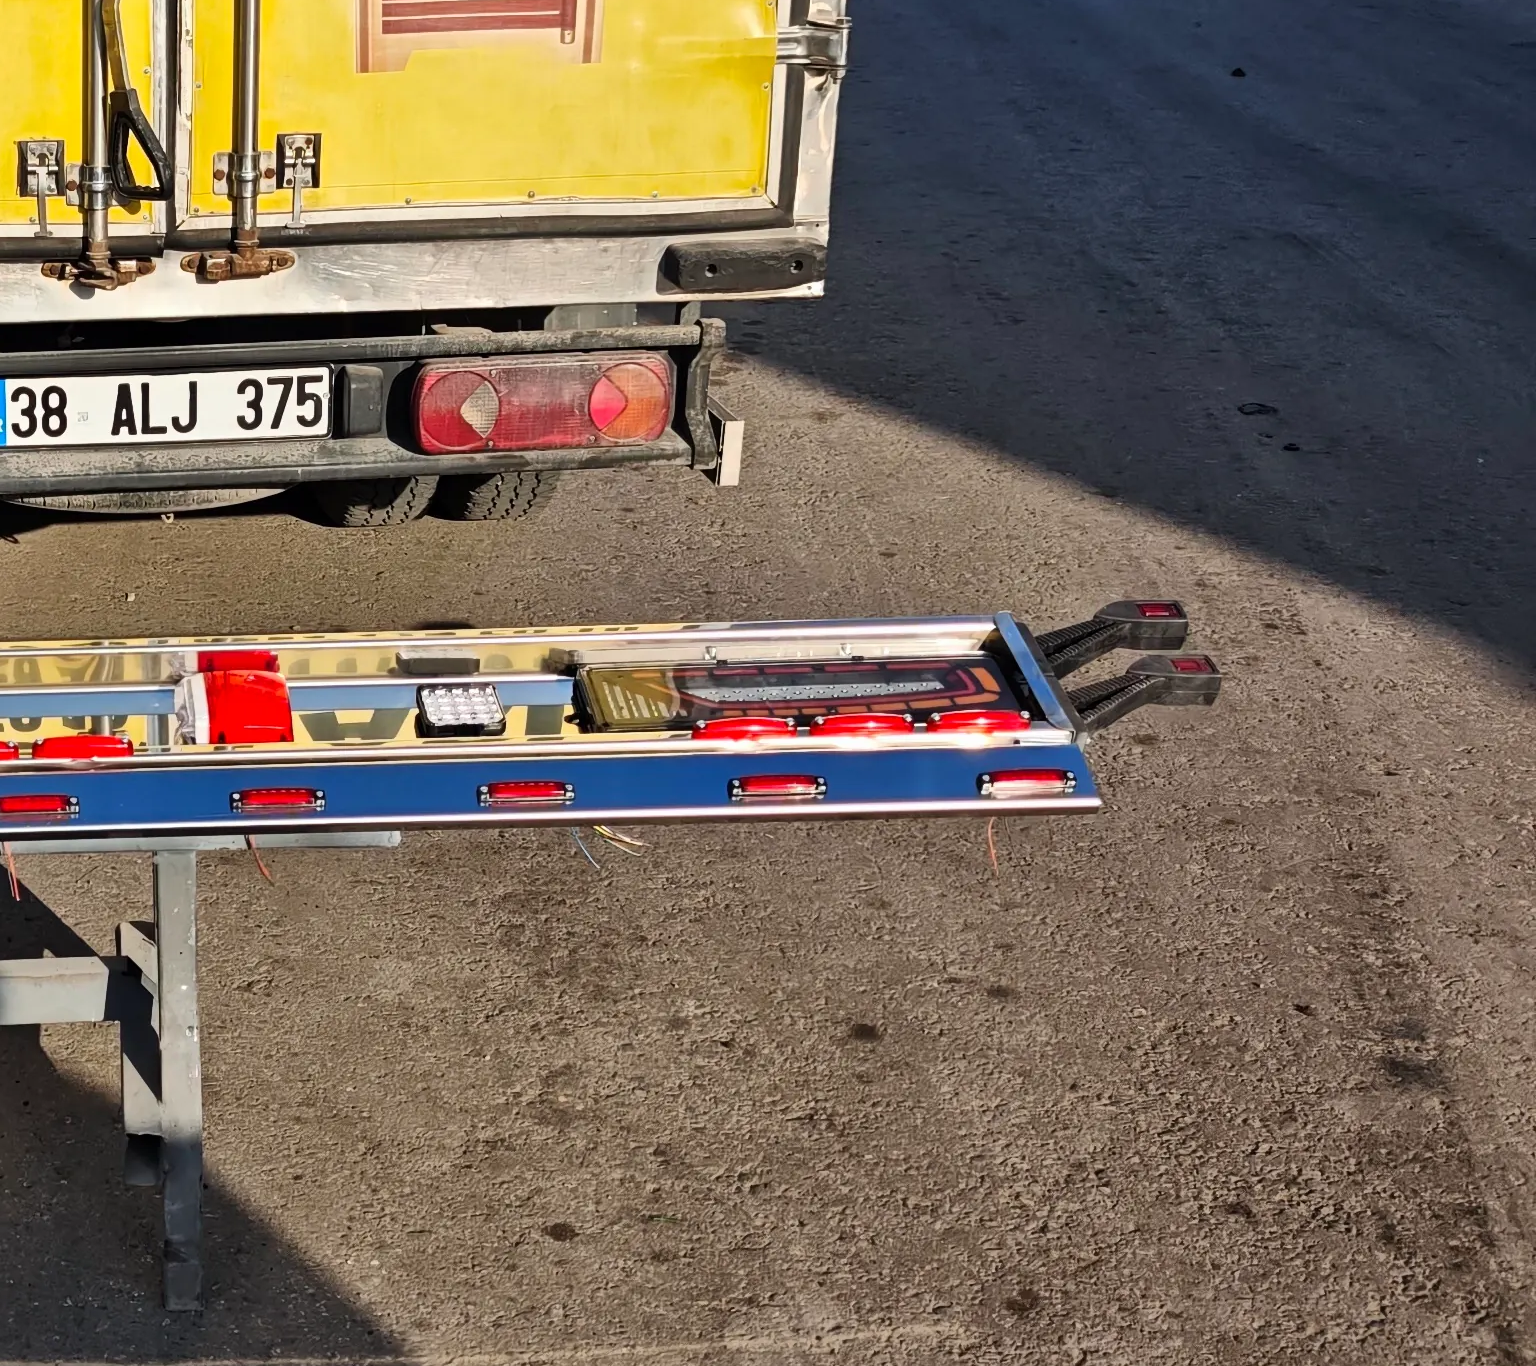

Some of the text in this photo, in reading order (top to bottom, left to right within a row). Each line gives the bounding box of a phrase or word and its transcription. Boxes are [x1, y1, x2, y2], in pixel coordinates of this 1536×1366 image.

[10, 374, 324, 439] 38 ALJ 375
